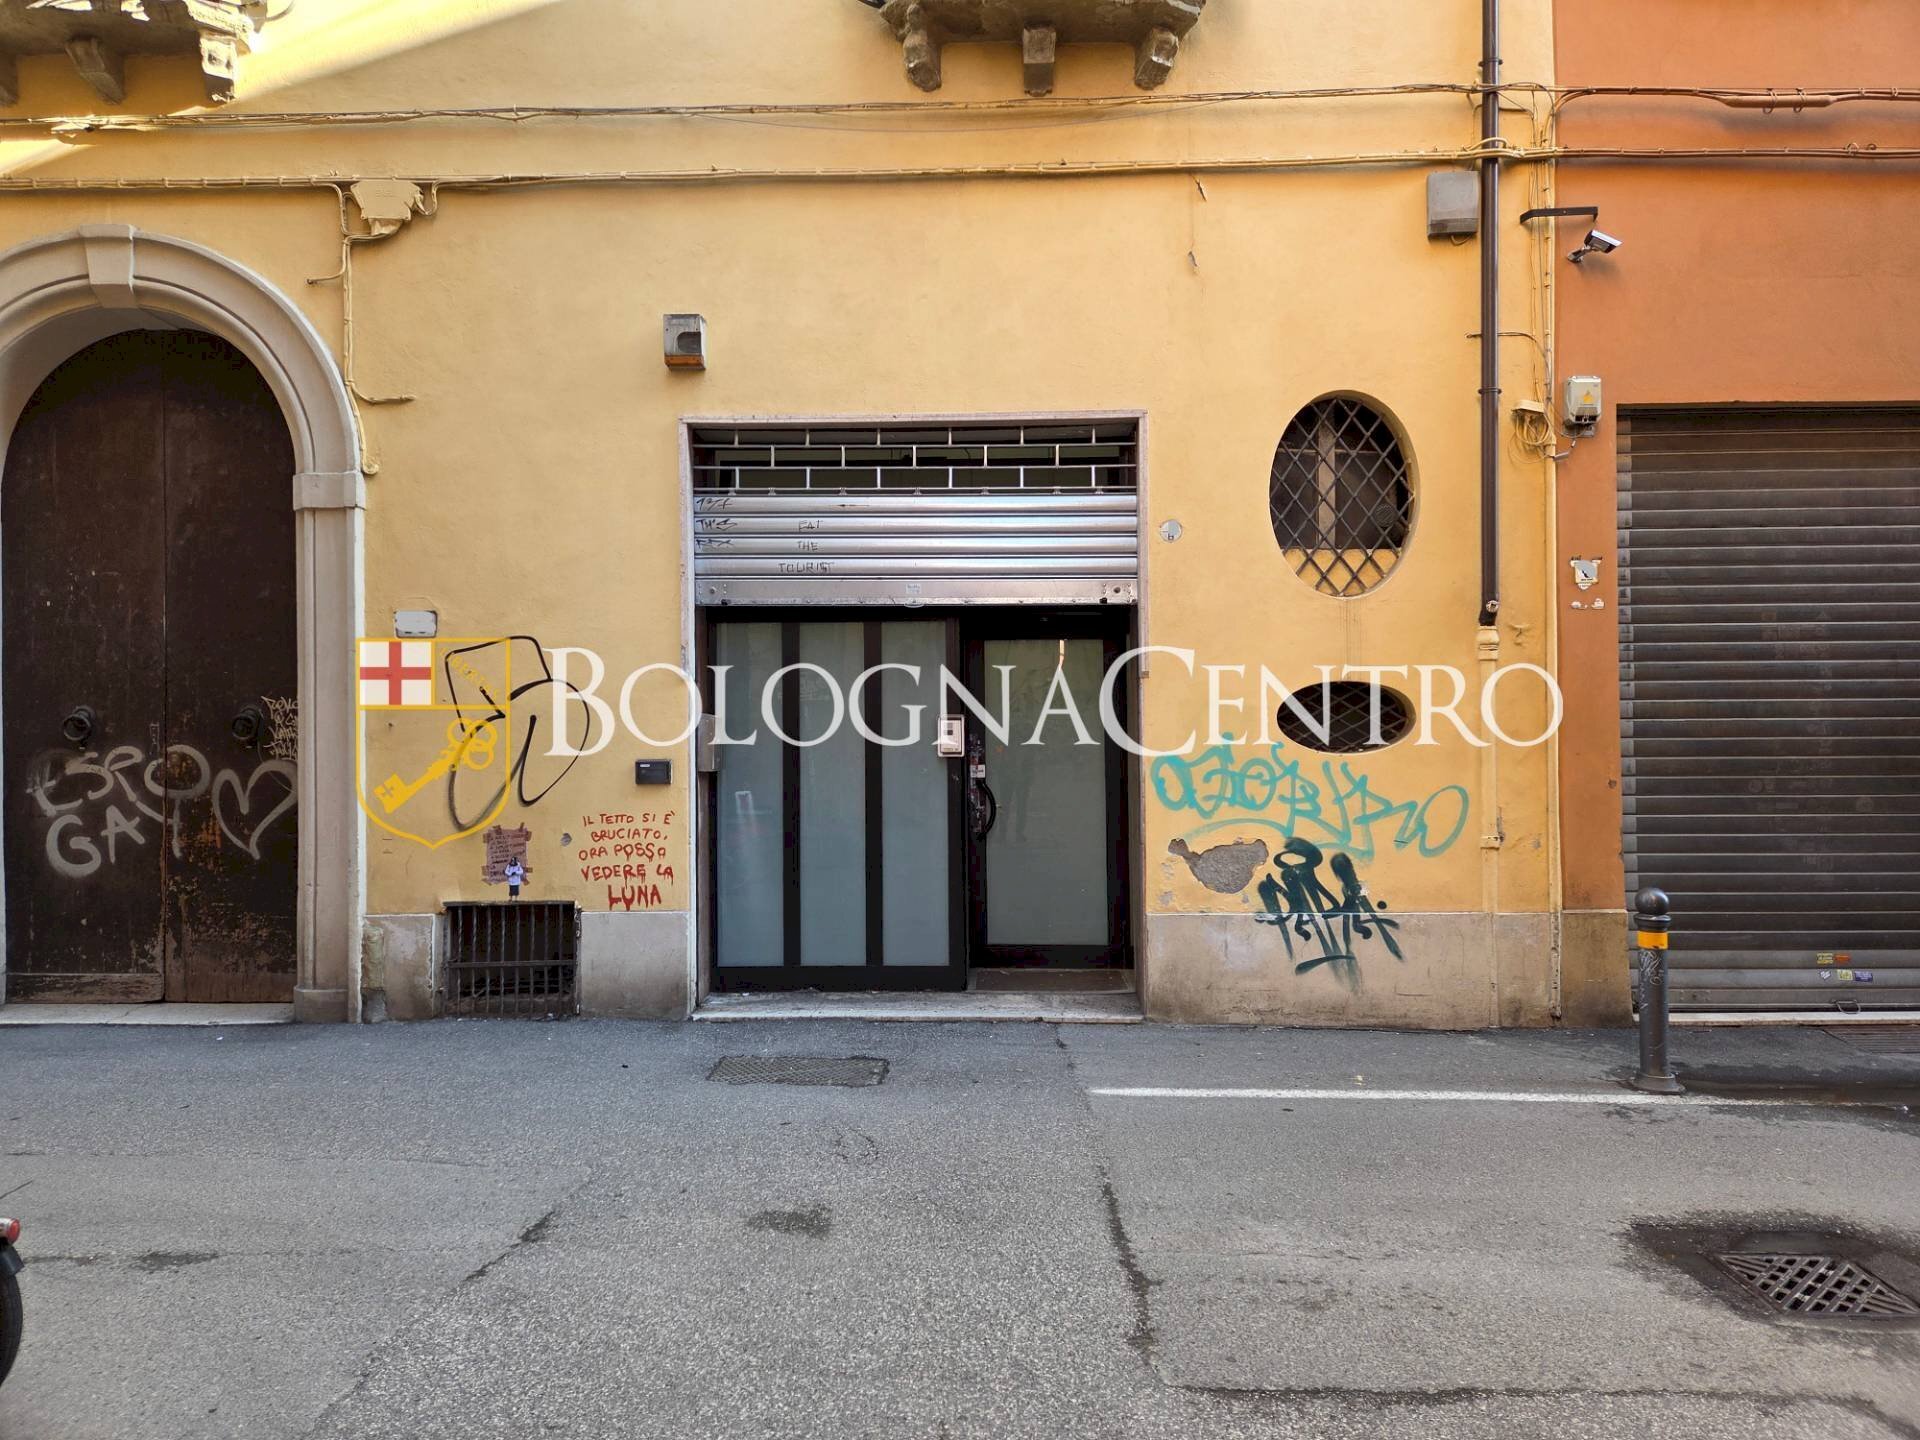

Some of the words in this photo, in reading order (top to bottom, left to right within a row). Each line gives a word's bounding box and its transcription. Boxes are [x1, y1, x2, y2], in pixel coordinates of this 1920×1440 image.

[799, 520, 823, 530] EAT
[797, 540, 819, 551] THE
[583, 816, 594, 827] IL
[600, 814, 634, 824] TETTO
[642, 813, 656, 823] SI
[591, 828, 668, 842] BRUCIATO,
[579, 846, 608, 861] ORA
[614, 842, 666, 862] POSSO
[581, 864, 647, 883] VEDERE
[656, 864, 673, 885] LA
[608, 884, 662, 911] LUNA
